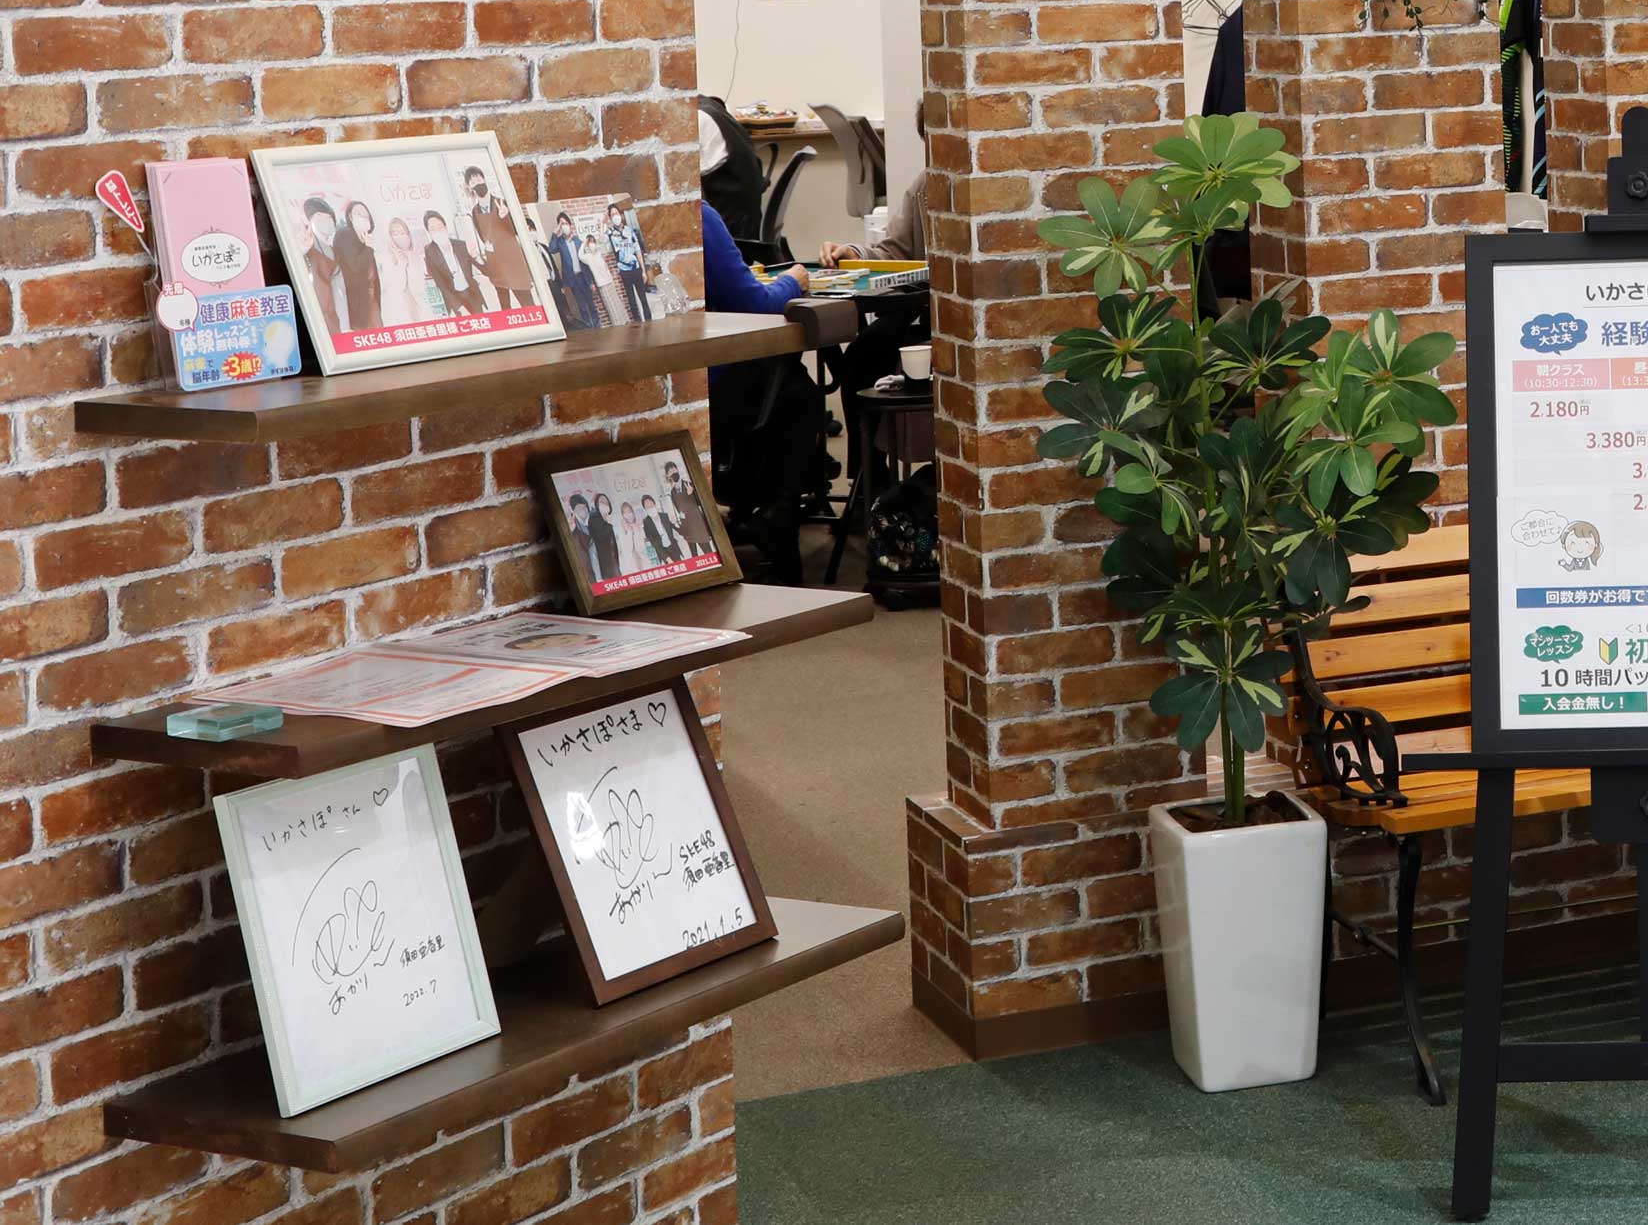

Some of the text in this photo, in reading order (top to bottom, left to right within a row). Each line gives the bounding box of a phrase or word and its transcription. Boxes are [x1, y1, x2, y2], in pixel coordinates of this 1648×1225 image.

[200, 295, 290, 324] 健康麻雀教室
[353, 333, 392, 349] SKE48
[506, 312, 543, 326] 2021.1.5
[1530, 321, 1579, 336] お一人でも
[1539, 334, 1573, 346] 大丈夫
[1536, 644, 1574, 657] レッスン
